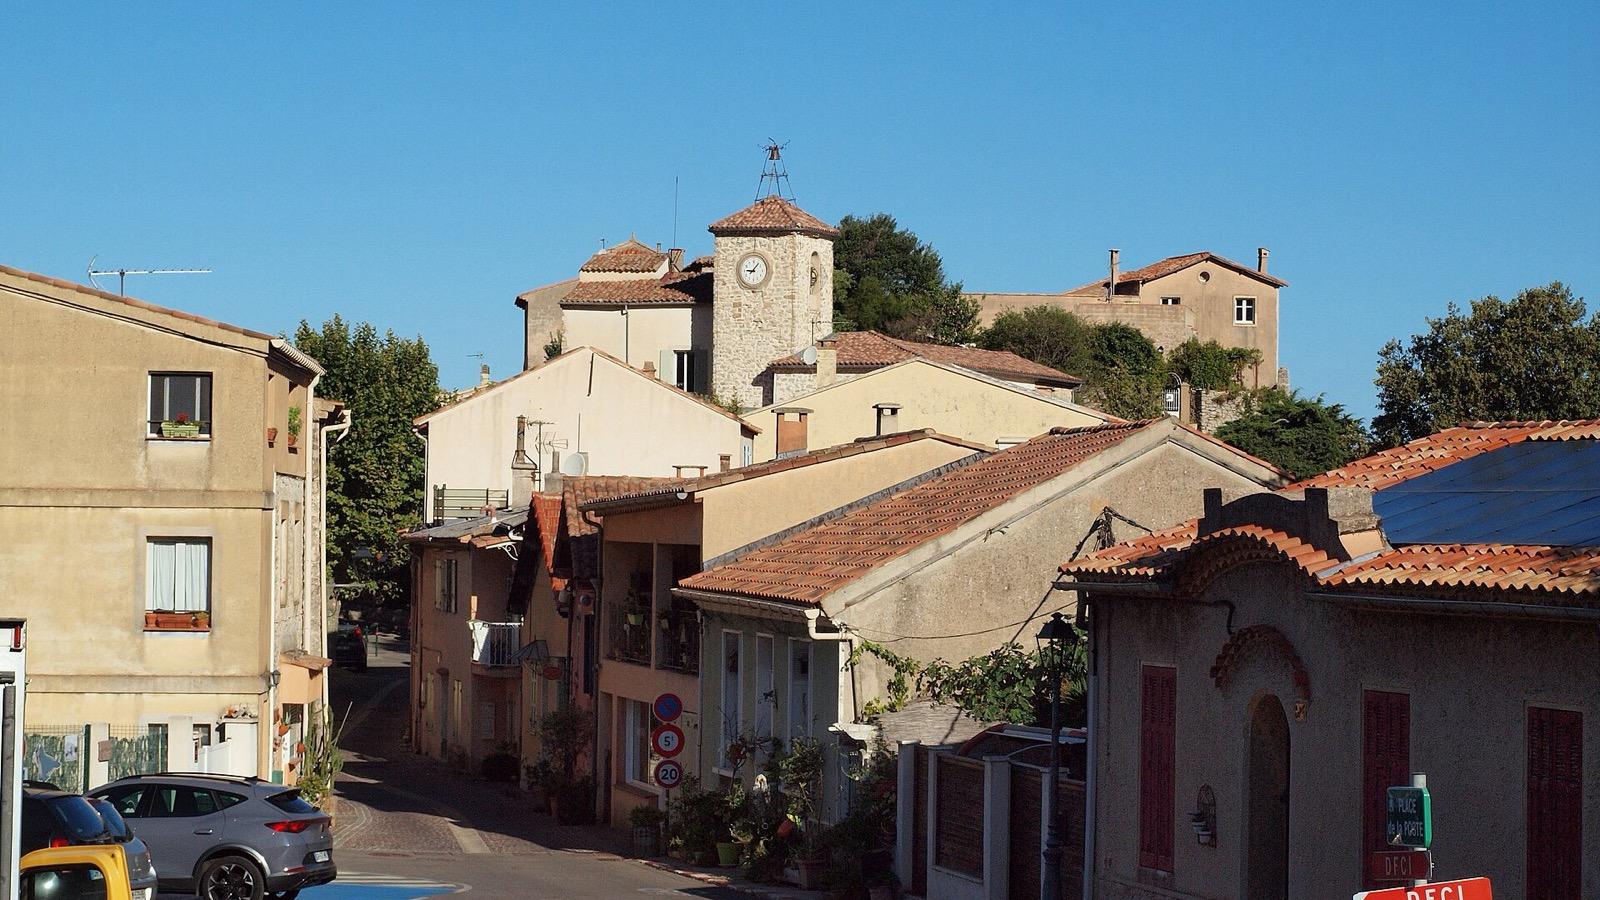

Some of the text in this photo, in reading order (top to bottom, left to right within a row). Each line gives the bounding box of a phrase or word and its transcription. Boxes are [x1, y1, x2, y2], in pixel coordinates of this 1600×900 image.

[661, 768, 678, 780] 20
[1398, 798, 1417, 813] PLACE
[1404, 820, 1424, 837] POSTE
[1385, 856, 1412, 876] DFCI
